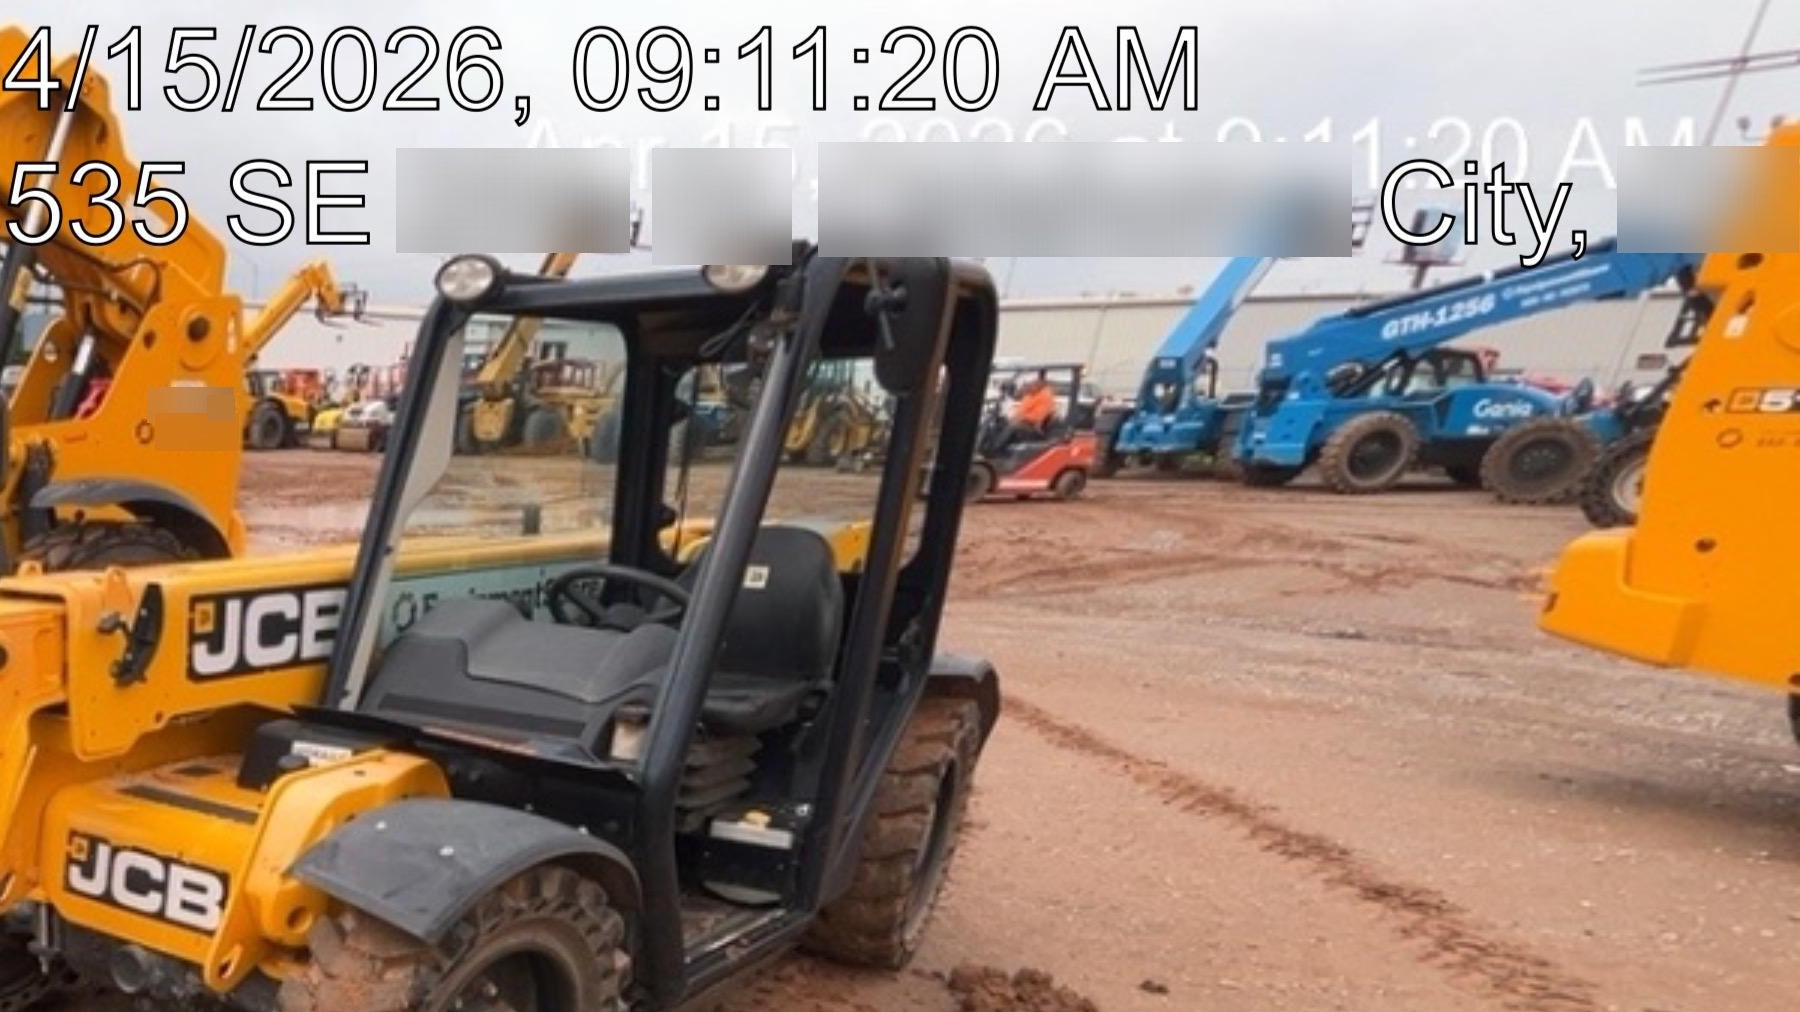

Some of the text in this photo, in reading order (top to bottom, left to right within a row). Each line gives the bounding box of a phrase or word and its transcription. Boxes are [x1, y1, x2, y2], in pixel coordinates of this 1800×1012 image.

[1380, 293, 1497, 340] GTH-1256
[190, 587, 347, 677] JCB
[66, 841, 226, 932] JCB
